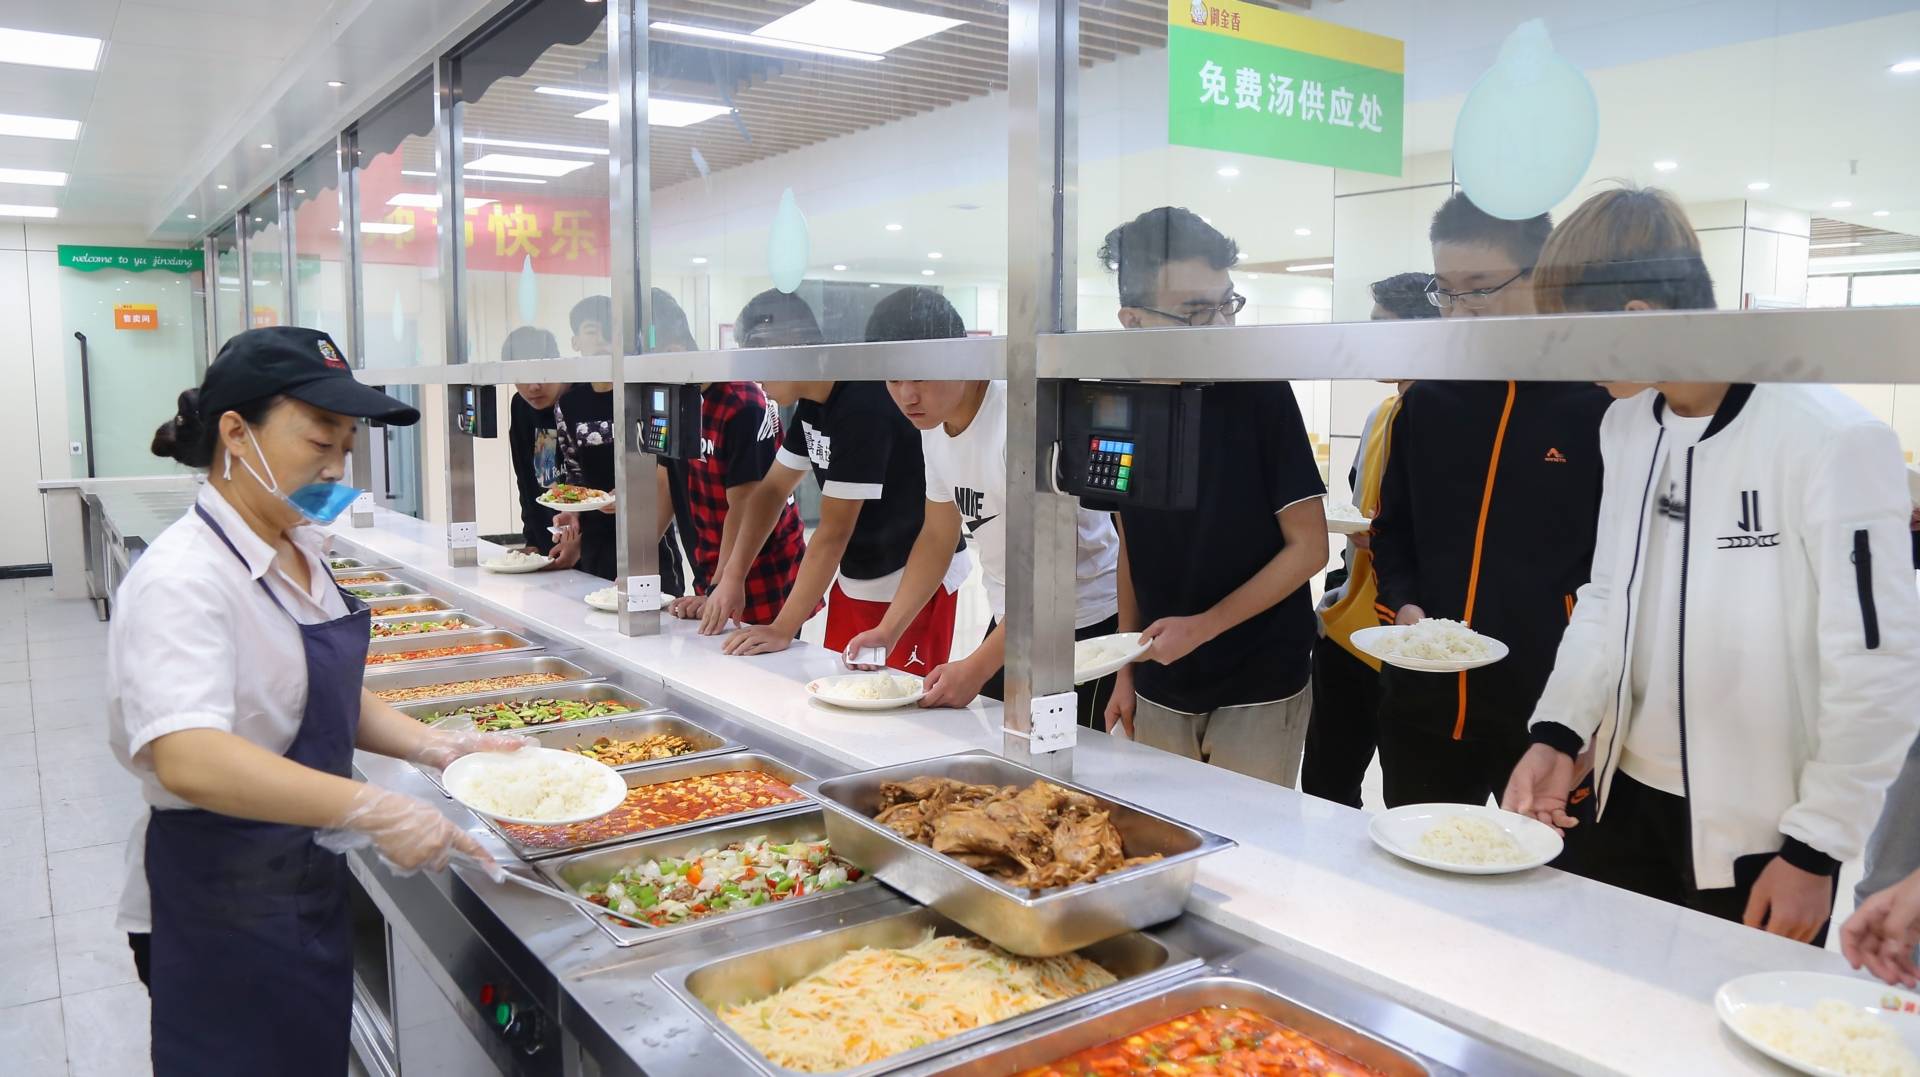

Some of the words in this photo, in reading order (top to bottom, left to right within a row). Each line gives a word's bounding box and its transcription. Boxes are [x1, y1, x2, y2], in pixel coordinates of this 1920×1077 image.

[1198, 60, 1384, 133] 免费汤供应处
[72, 253, 113, 264] welcome
[118, 256, 129, 264] to
[134, 257, 147, 267] yu
[152, 256, 193, 269] jinxiang
